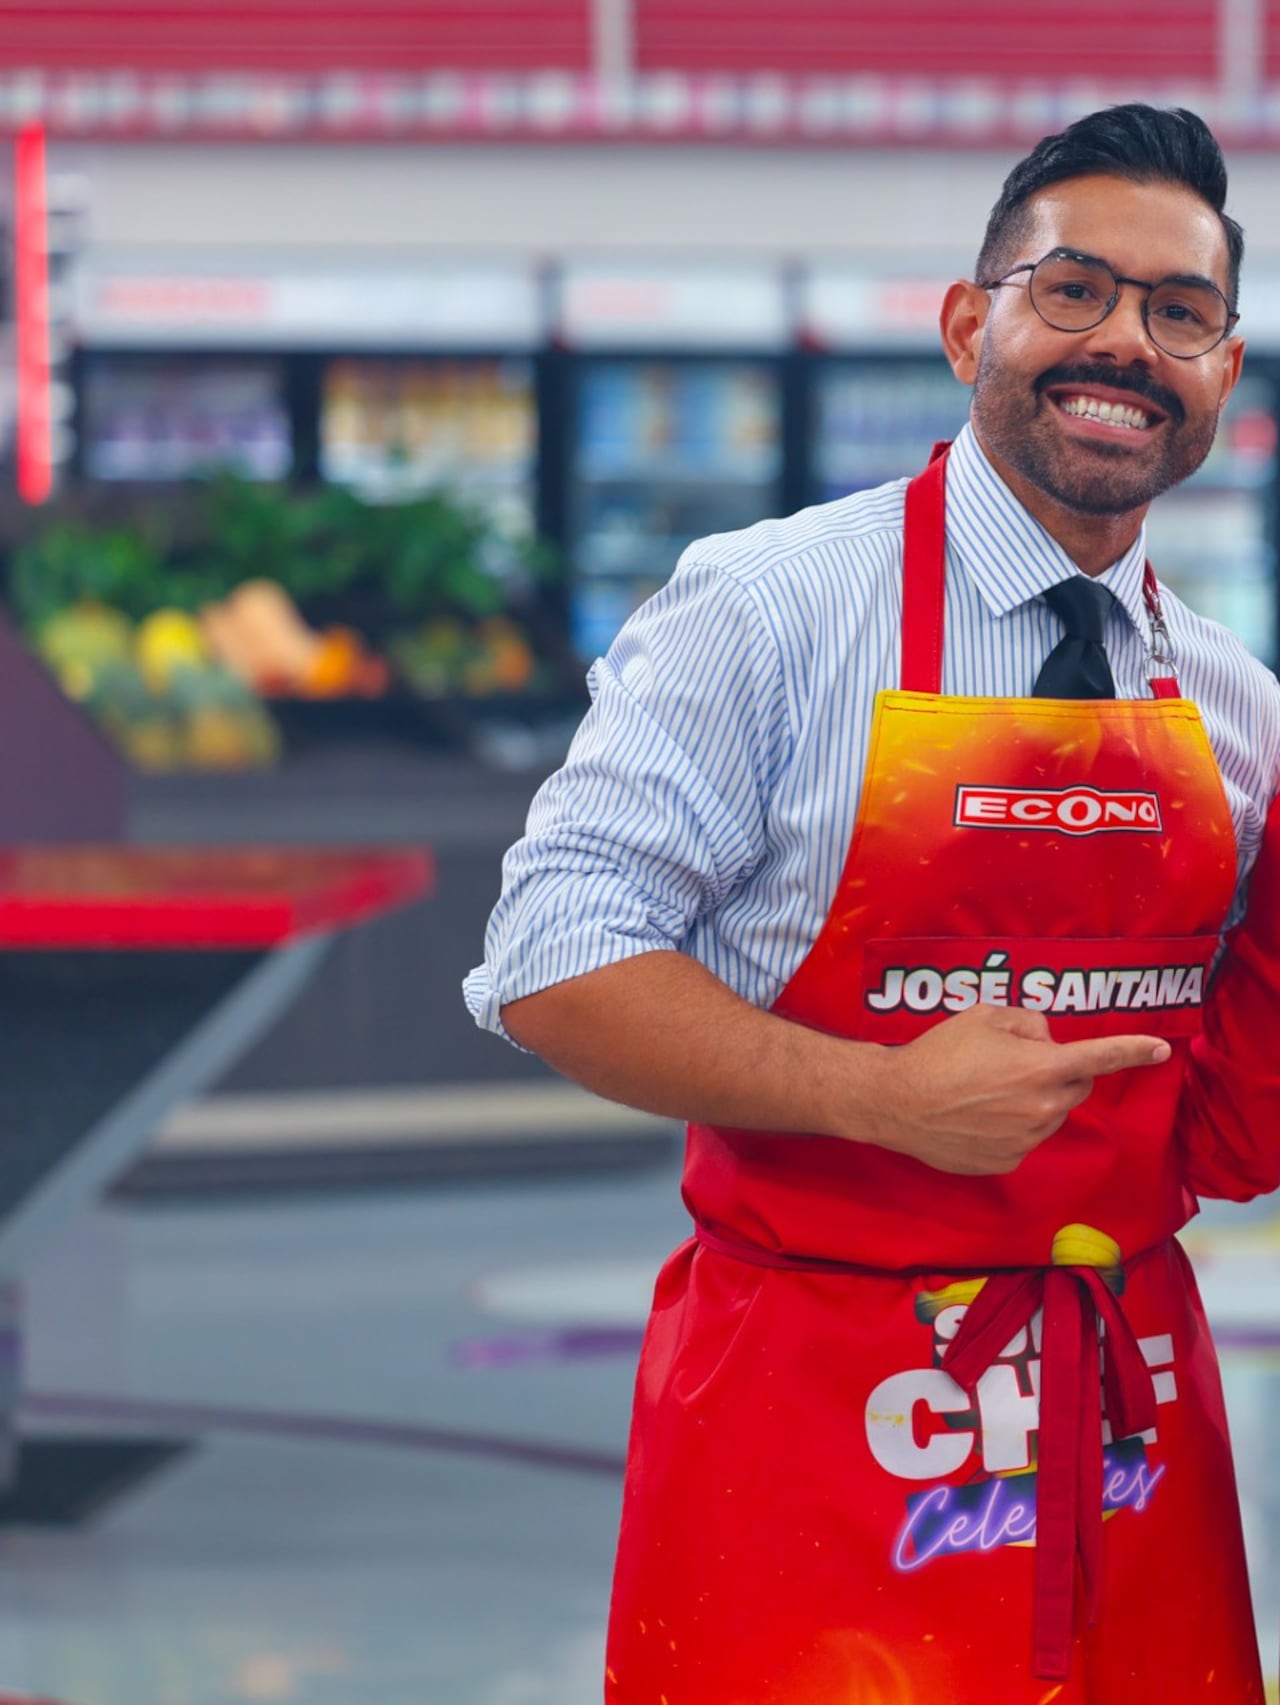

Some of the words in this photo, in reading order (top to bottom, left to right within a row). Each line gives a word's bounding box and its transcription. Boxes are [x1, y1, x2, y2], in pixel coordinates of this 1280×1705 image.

[964, 795, 1157, 826] ECONO
[867, 953, 1011, 1013] JOSÉ
[1021, 966, 1205, 1013] SANTANA
